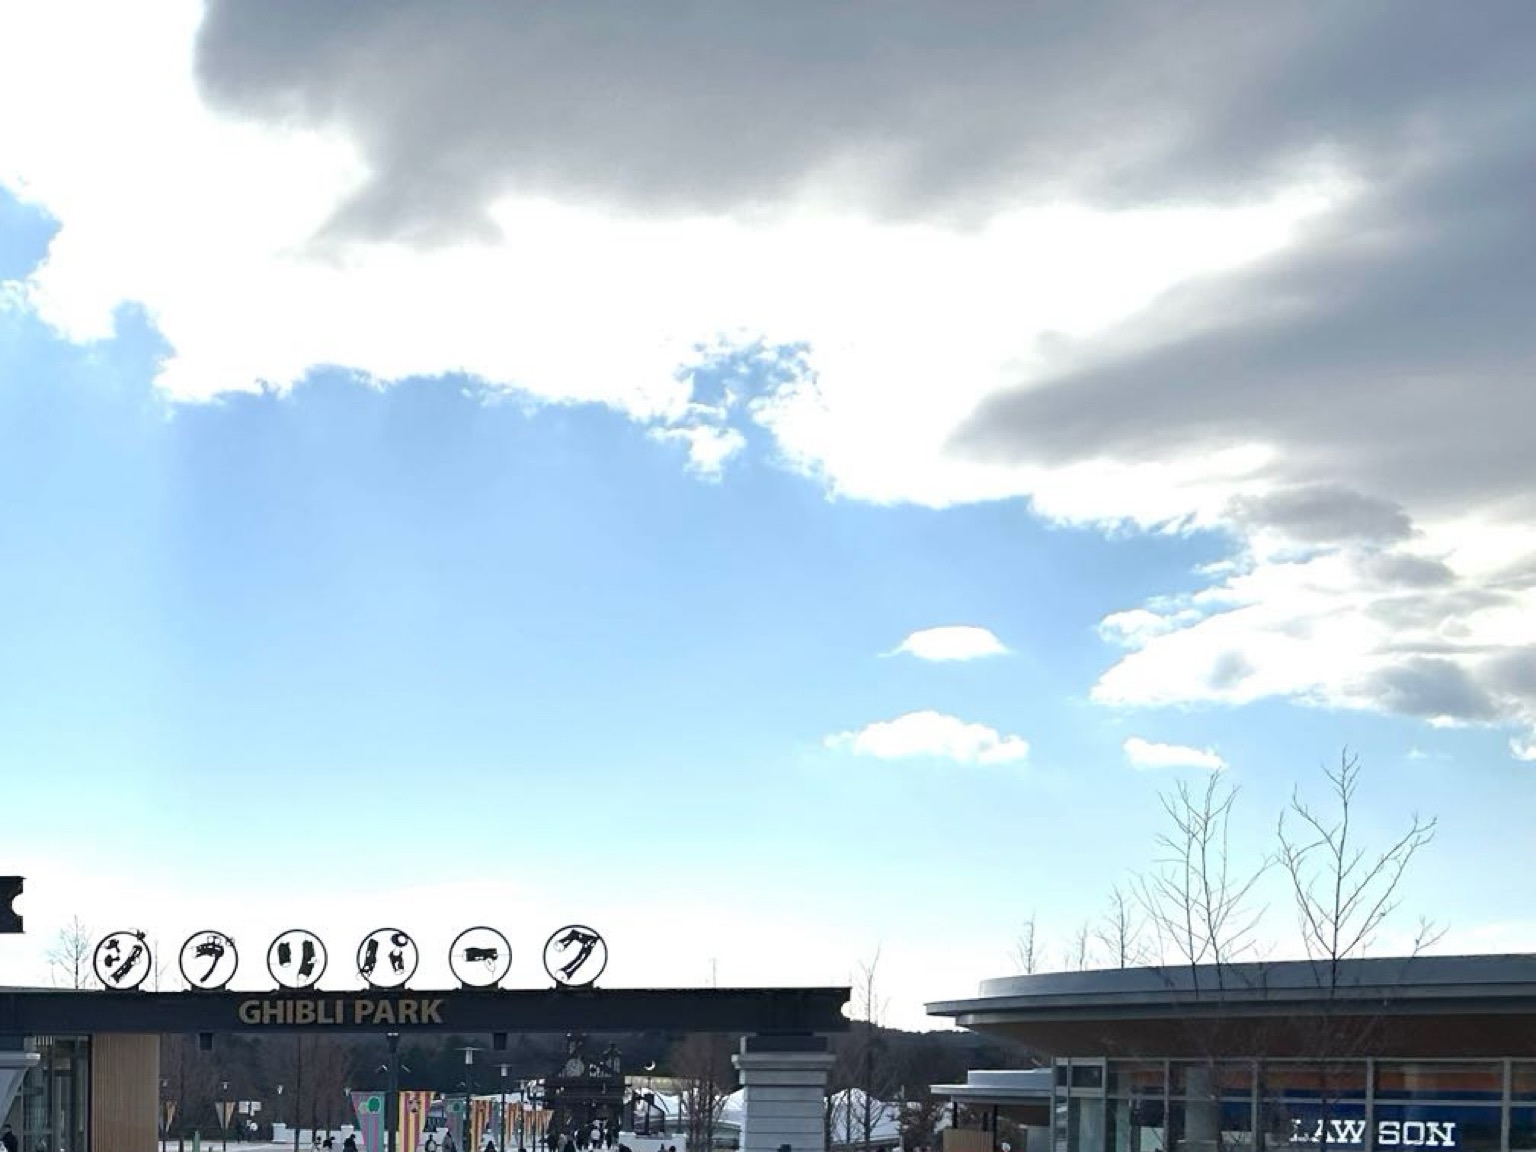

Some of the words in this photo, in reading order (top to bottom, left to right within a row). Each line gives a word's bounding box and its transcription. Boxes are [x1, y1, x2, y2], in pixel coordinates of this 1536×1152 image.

[238, 999, 344, 1024] GHIBLI
[354, 999, 443, 1024] PARK
[1289, 1118, 1456, 1147] LAWSON
